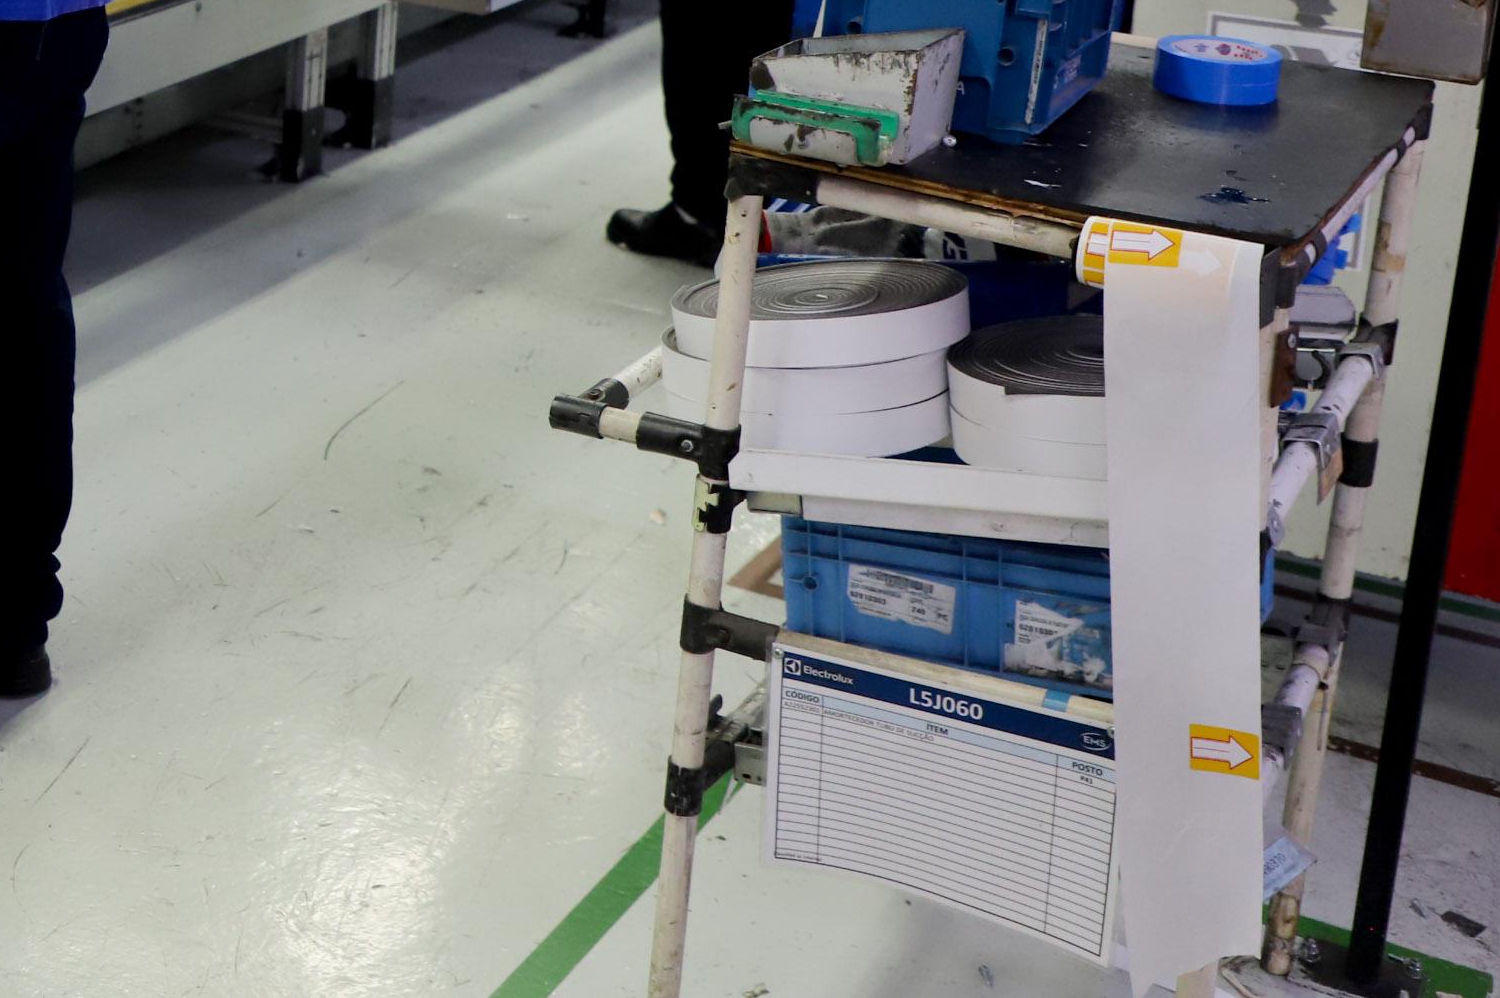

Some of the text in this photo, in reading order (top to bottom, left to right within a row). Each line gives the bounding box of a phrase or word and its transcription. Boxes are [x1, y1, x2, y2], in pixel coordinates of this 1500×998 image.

[803, 665, 854, 686] Electrolux
[909, 687, 984, 720] L5J060
[785, 689, 820, 704] CÓDIGO
[1071, 761, 1104, 777] POSTO
[1082, 734, 1106, 749] EMS
